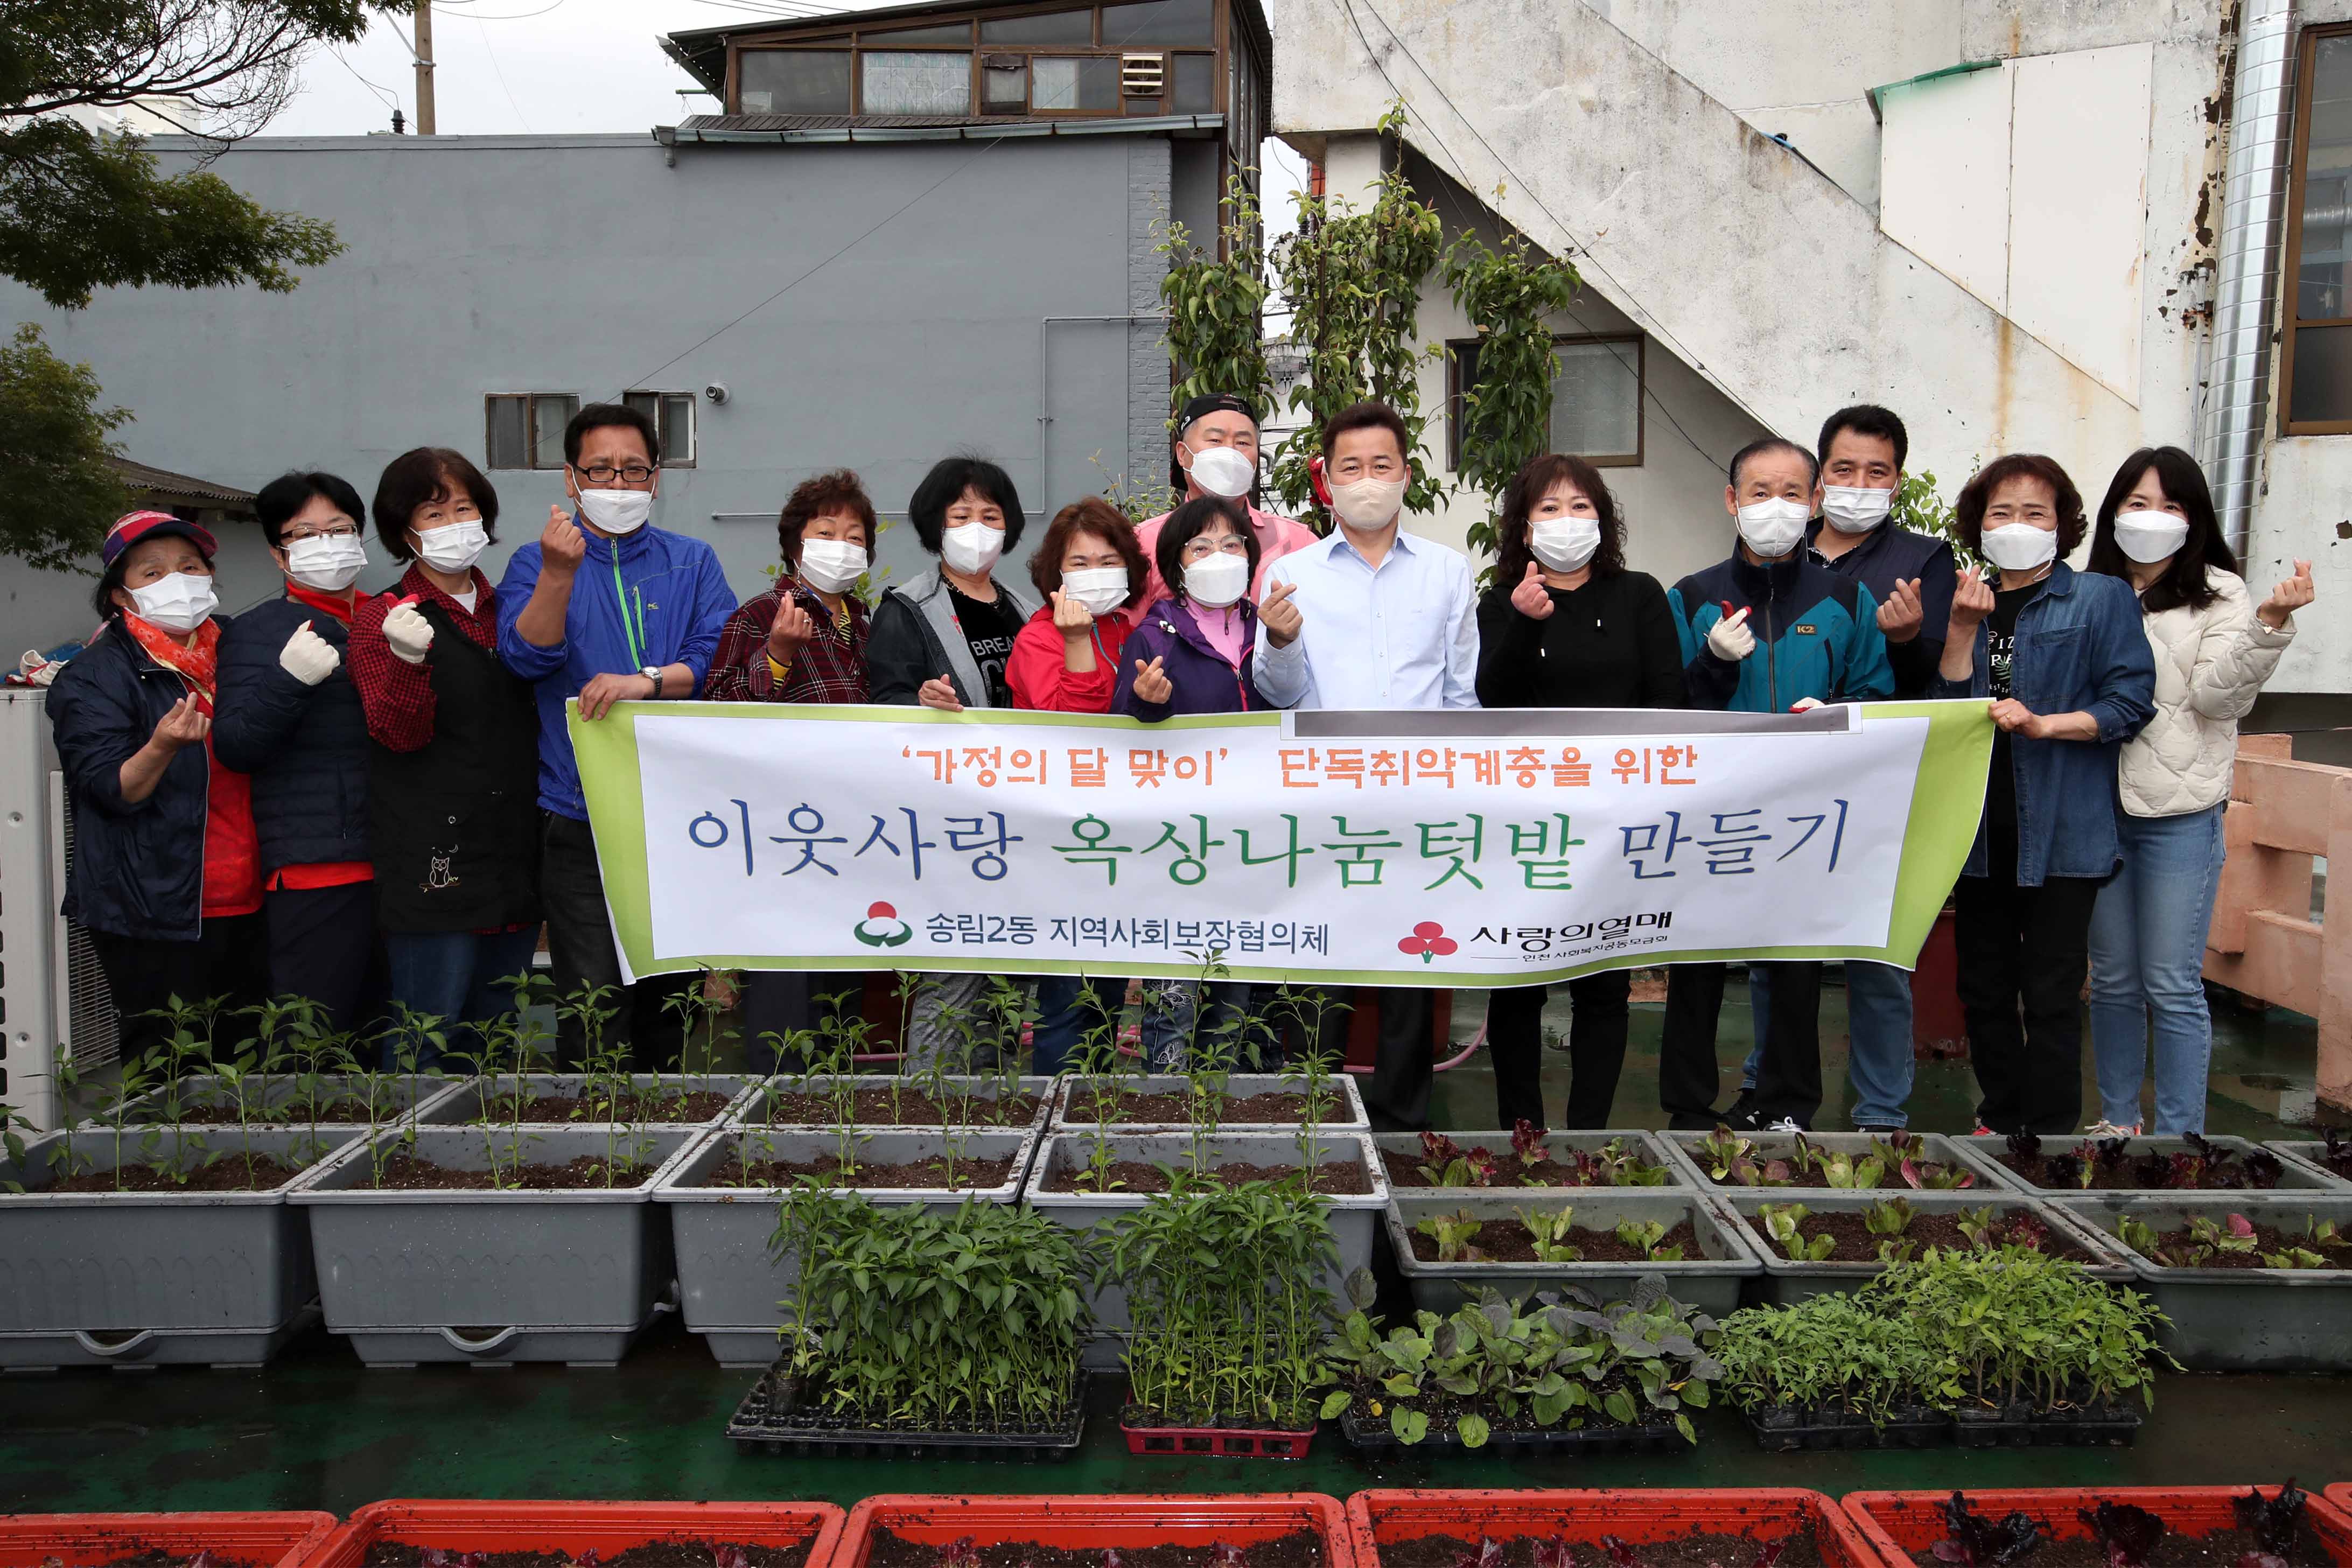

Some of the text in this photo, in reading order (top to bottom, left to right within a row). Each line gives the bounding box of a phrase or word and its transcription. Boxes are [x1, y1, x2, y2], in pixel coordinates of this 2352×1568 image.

[971, 635, 1016, 656] BREA
[1797, 625, 1814, 633] K2
[1069, 747, 1109, 788] 달
[1278, 746, 1592, 789] 단독취약계층을
[1611, 745, 1698, 786] 위한
[688, 799, 1024, 881] 이웃사랑
[1618, 799, 1849, 880] 만들기
[925, 912, 1329, 957] 송림2동 지역사회보장협의체
[1470, 911, 1673, 953] 사랑의열매
[1522, 935, 1668, 962] 인천 사회복지공동모금회
